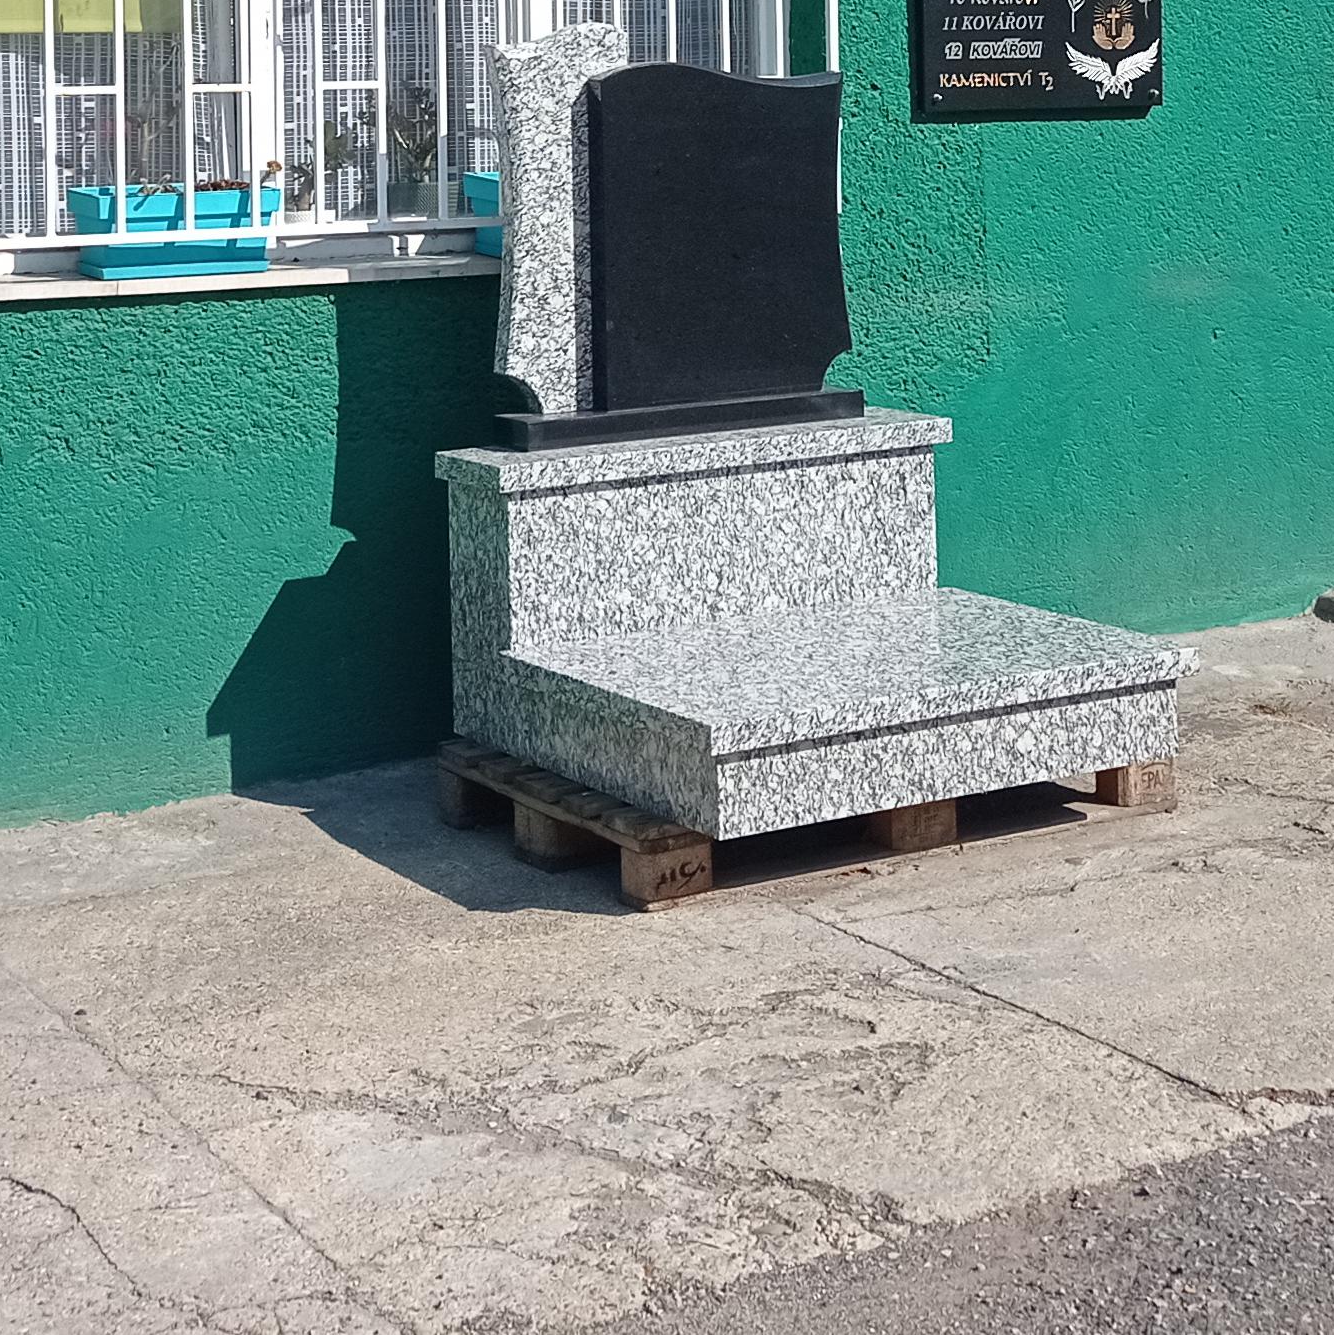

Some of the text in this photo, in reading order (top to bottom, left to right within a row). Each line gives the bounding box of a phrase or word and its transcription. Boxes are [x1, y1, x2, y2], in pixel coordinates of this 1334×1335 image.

[942, 11, 1045, 31] 11 KOVÁŘOVI
[945, 38, 1043, 60] 12 KOVÁŘOVI
[939, 70, 1033, 88] KAMENICTVÍ
